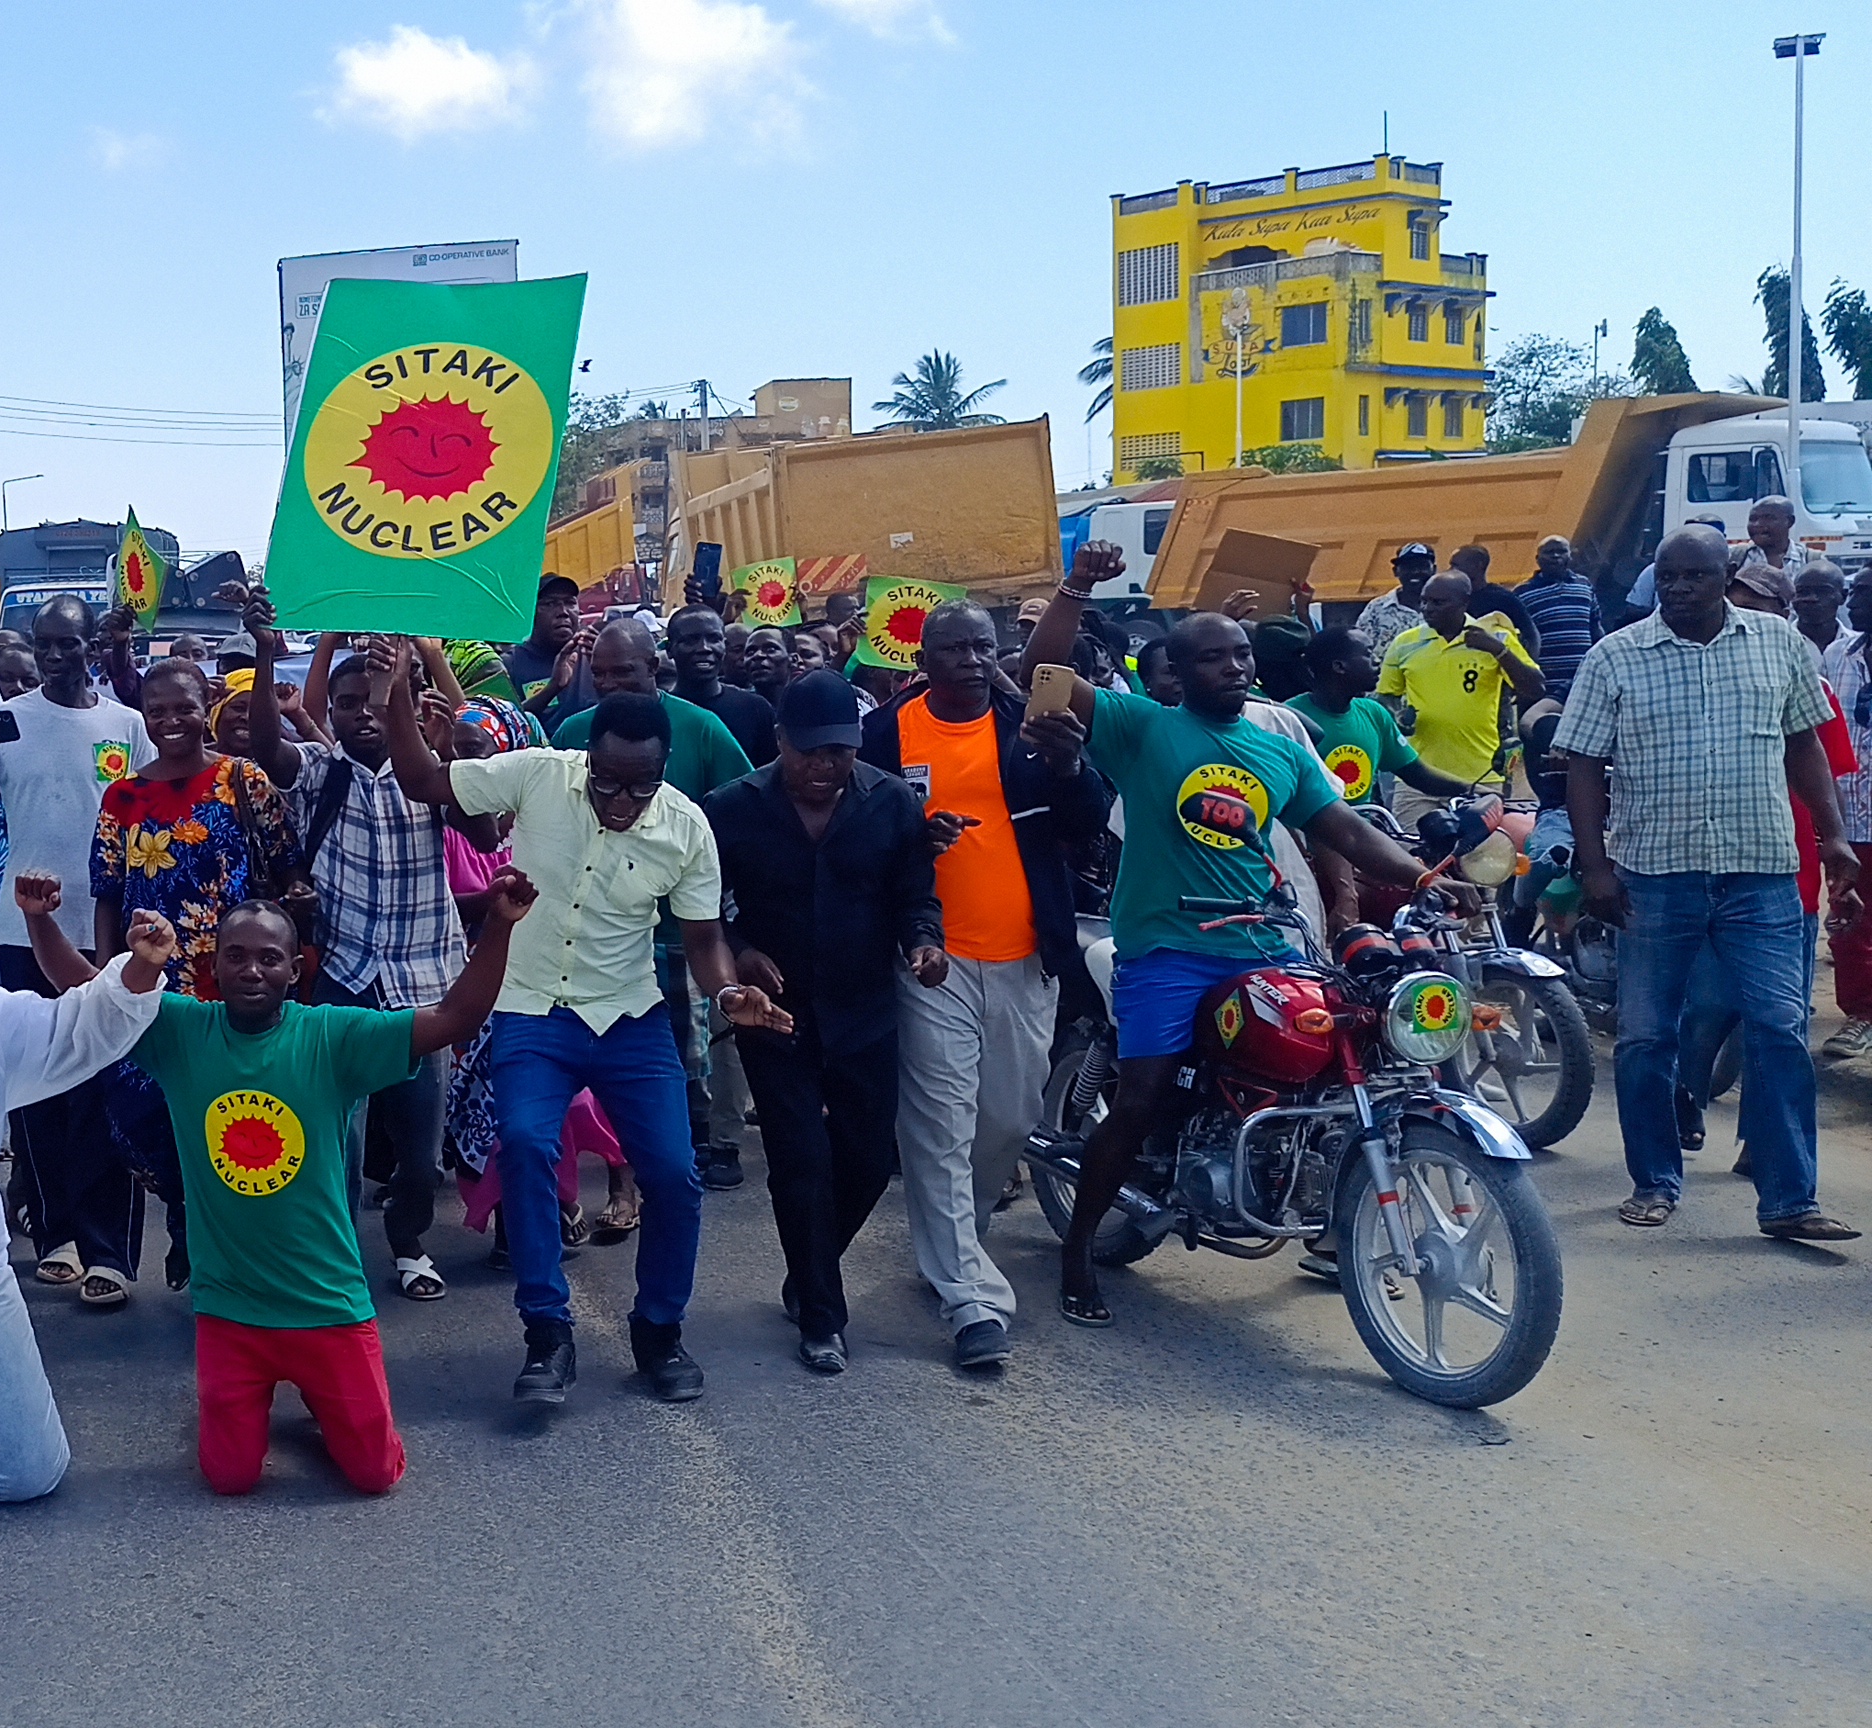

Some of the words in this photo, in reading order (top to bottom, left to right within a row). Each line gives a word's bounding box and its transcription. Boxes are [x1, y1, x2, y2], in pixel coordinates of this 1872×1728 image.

[1204, 220, 1245, 241] Kula
[1249, 218, 1291, 239] Supa
[1336, 204, 1381, 225] Supa
[486, 248, 510, 258] BANK
[299, 303, 310, 317] ZA
[312, 303, 320, 316] S
[364, 348, 520, 395] SITAKI
[318, 482, 518, 553] NUCLEAR
[132, 531, 150, 566] SITAKI
[748, 564, 784, 583] SITAKI
[887, 585, 942, 607] SITAKI
[752, 601, 792, 624] NUCLEAR
[871, 635, 917, 664] NUCLE
[1463, 669, 1479, 694] 8
[1333, 746, 1364, 758] SITAKI
[1199, 767, 1259, 790] SITAKI
[1201, 797, 1246, 828] TOO
[1184, 819, 1237, 846] UCLE
[1248, 973, 1290, 1006] HUNTER
[1416, 994, 1427, 1023] SITAKI
[1441, 988, 1455, 1024] NUCLEAR
[216, 1093, 284, 1117] SITAKI
[214, 1155, 301, 1194] NUCLEAR
